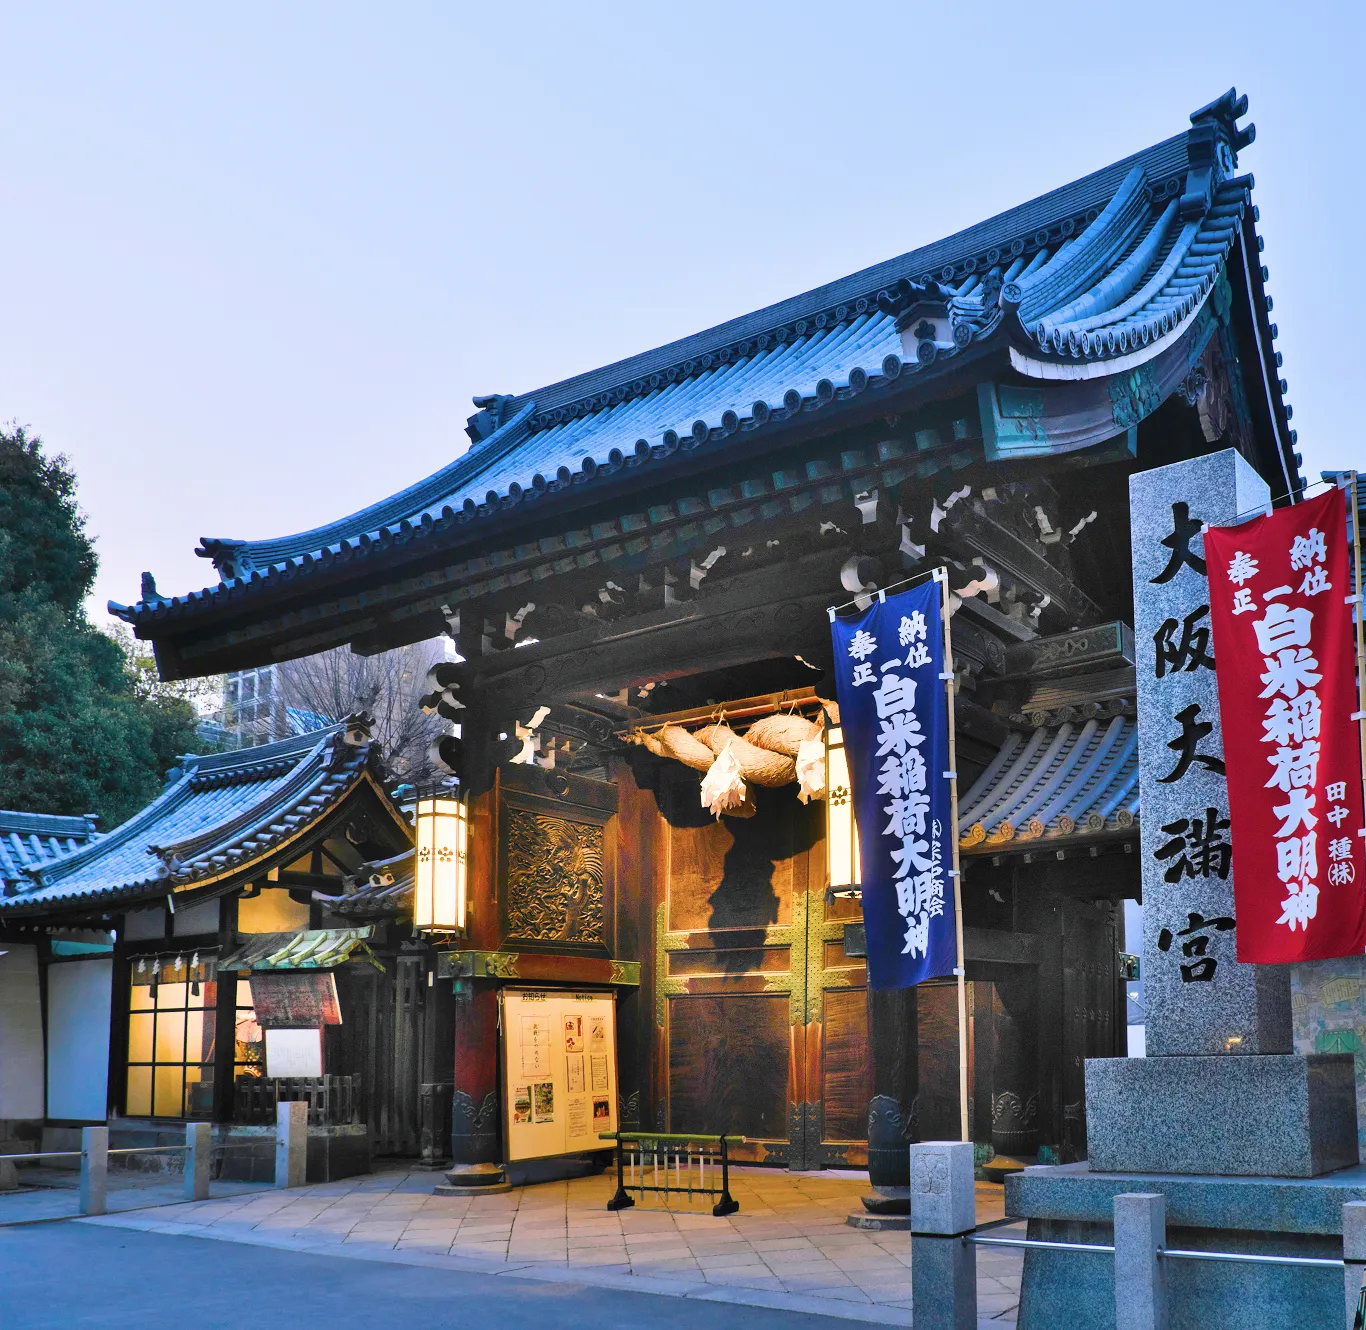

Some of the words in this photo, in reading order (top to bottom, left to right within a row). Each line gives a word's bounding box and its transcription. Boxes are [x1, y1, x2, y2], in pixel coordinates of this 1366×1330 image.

[1149, 501, 1236, 983] 大阪天満宮
[522, 992, 546, 1001] お知らせ
